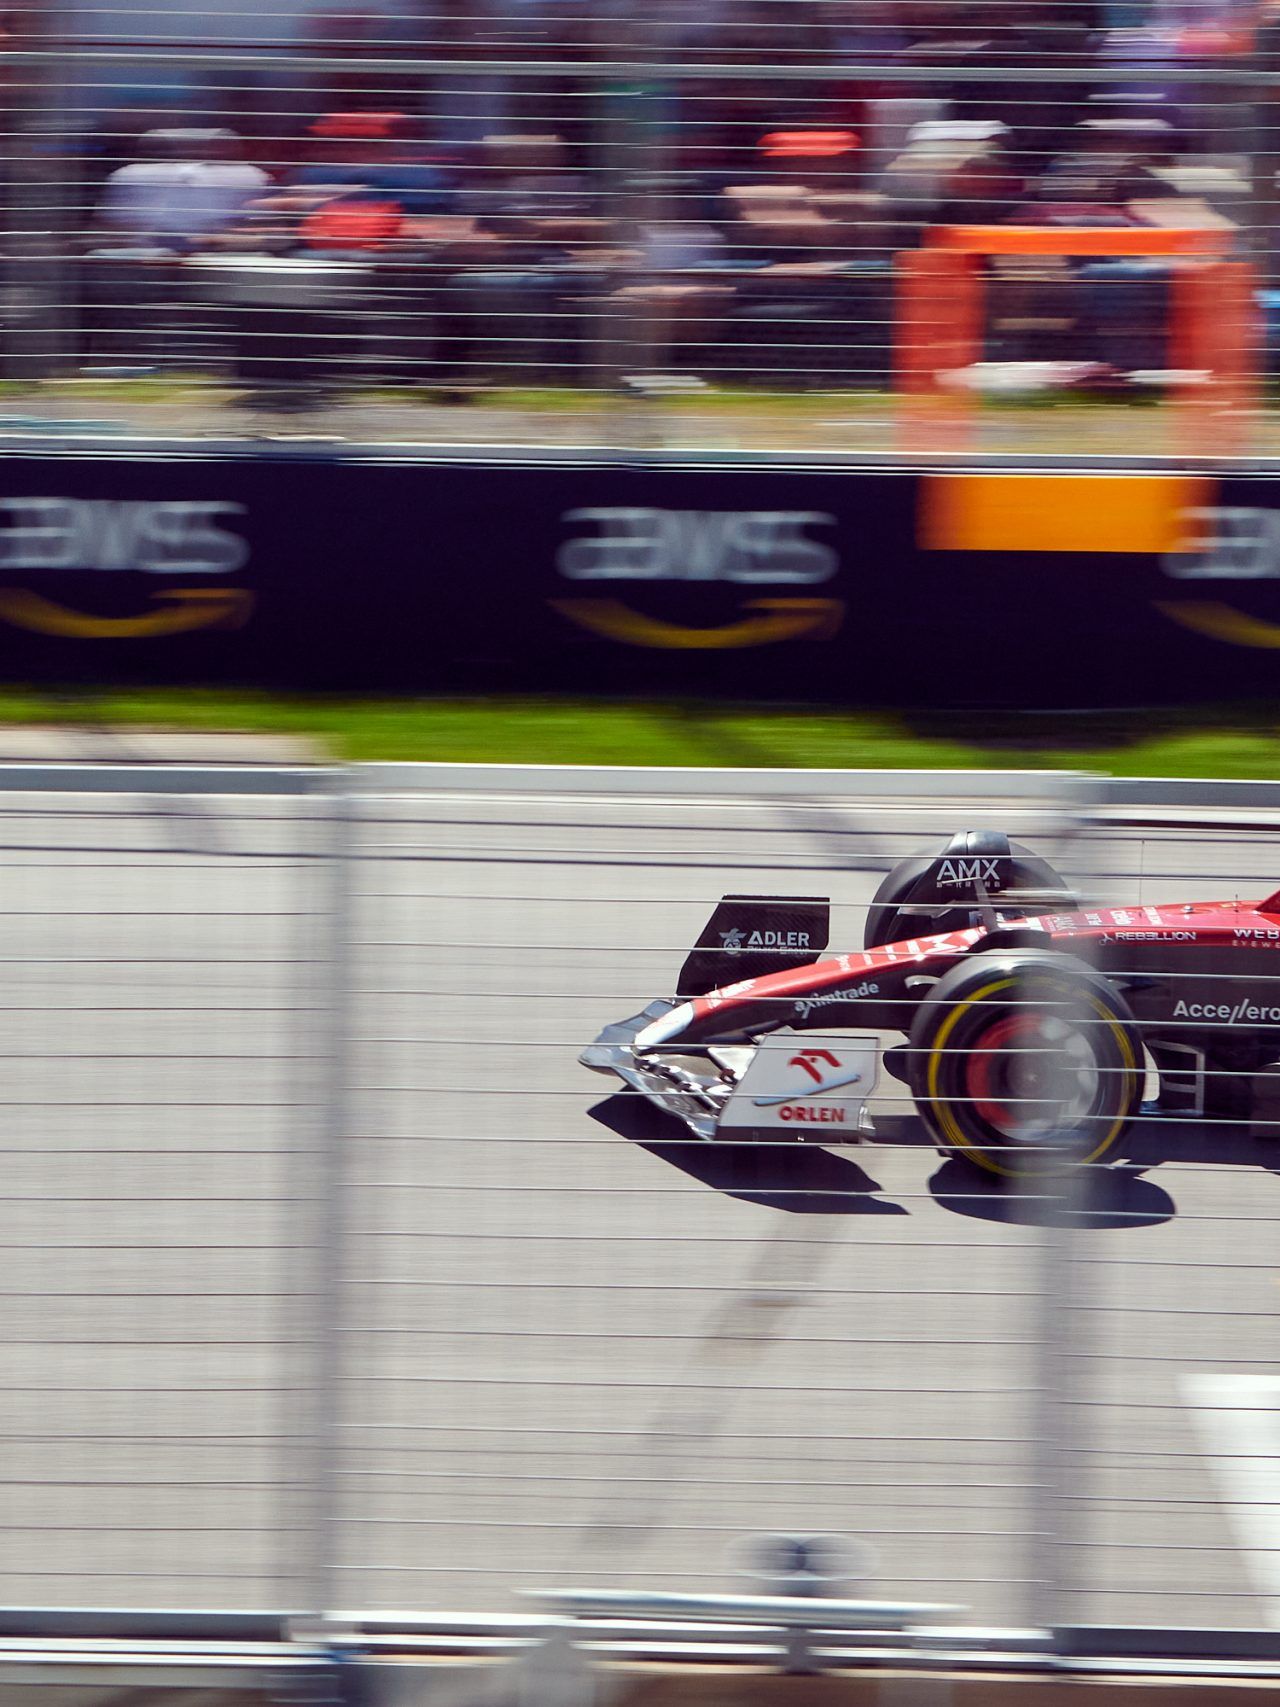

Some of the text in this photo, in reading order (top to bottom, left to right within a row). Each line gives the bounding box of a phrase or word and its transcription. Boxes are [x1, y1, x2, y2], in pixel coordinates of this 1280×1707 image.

[555, 506, 841, 584] aws
[935, 859, 1001, 882] AMX
[747, 930, 810, 947] ADLER
[779, 1105, 846, 1123] ORLEN
